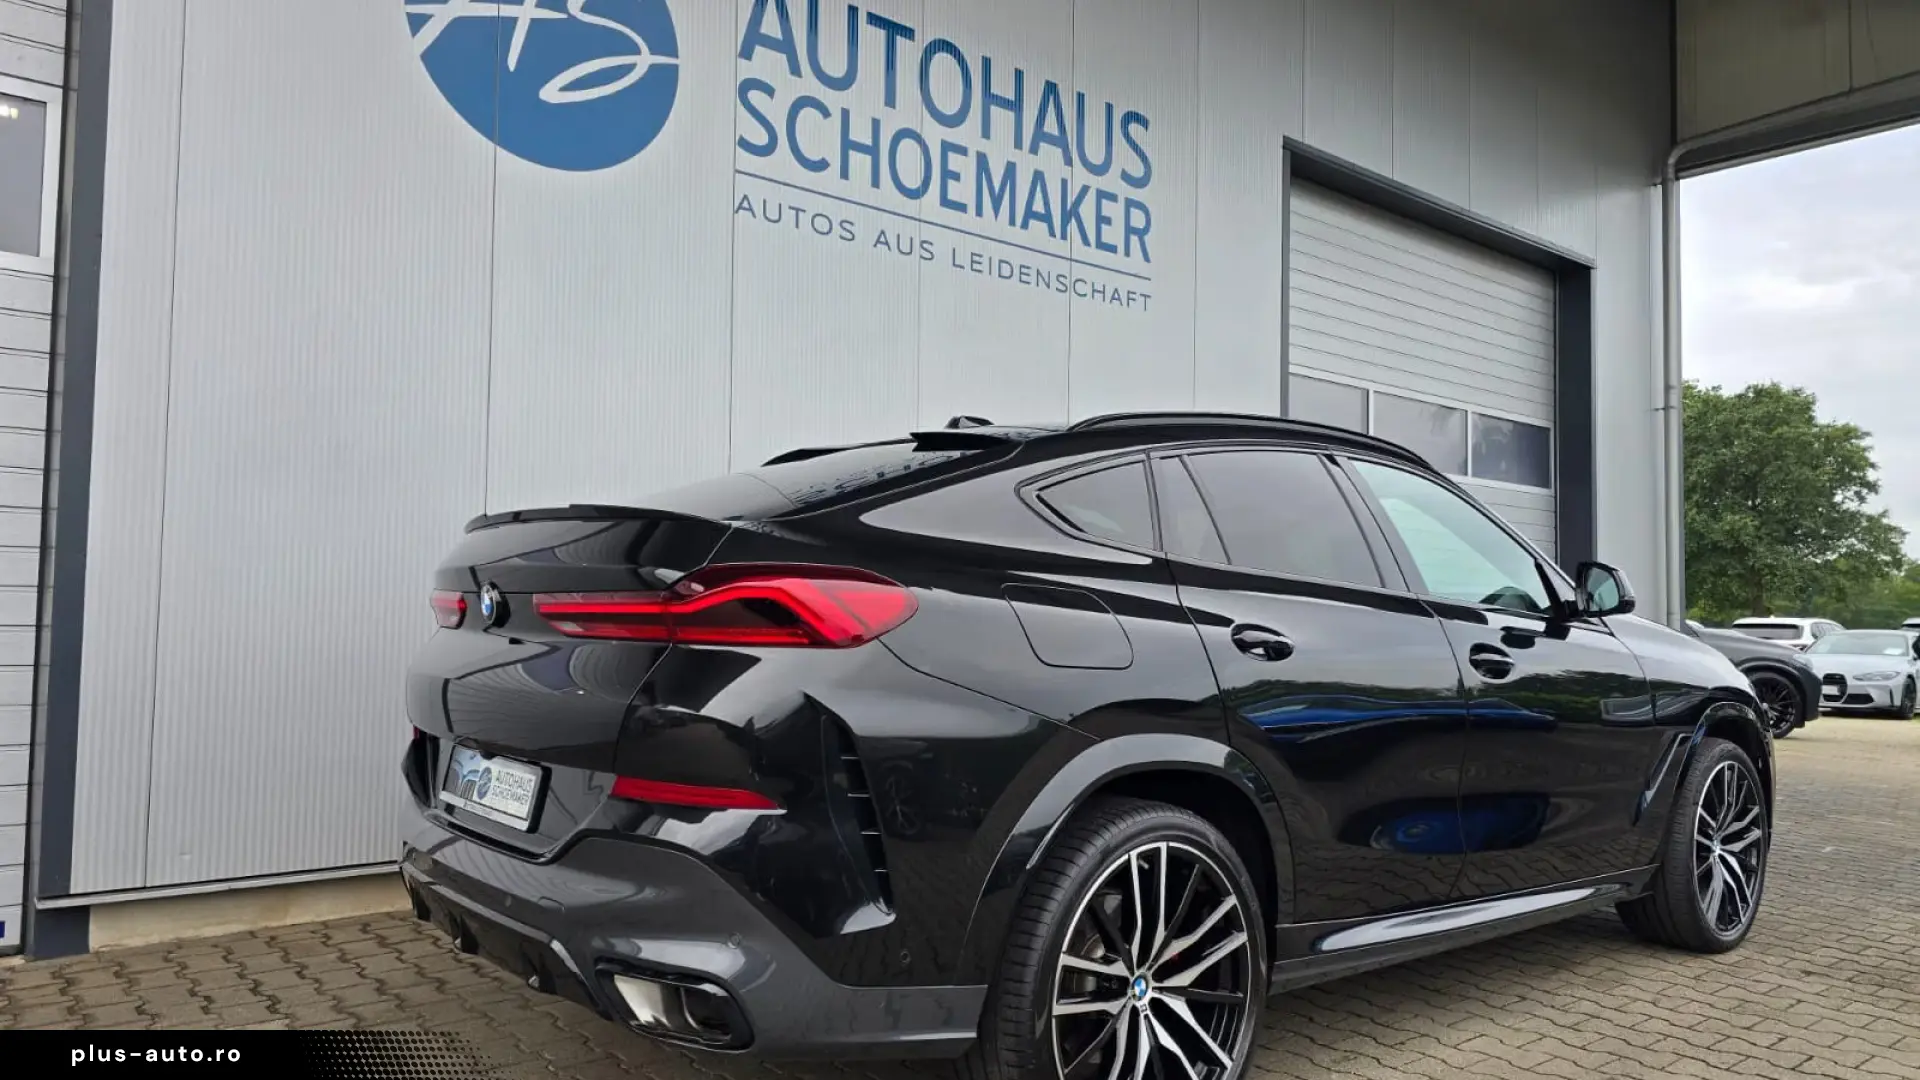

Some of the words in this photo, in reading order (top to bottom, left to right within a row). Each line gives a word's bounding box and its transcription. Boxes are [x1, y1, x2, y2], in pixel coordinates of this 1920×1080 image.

[736, 77, 1151, 263] SCHOEMAKER
[738, 0, 1151, 190] AUTOHAUS
[735, 194, 855, 242] AUTOS
[873, 229, 935, 261] AUS
[952, 247, 1152, 311] LEIDENSCHAFT
